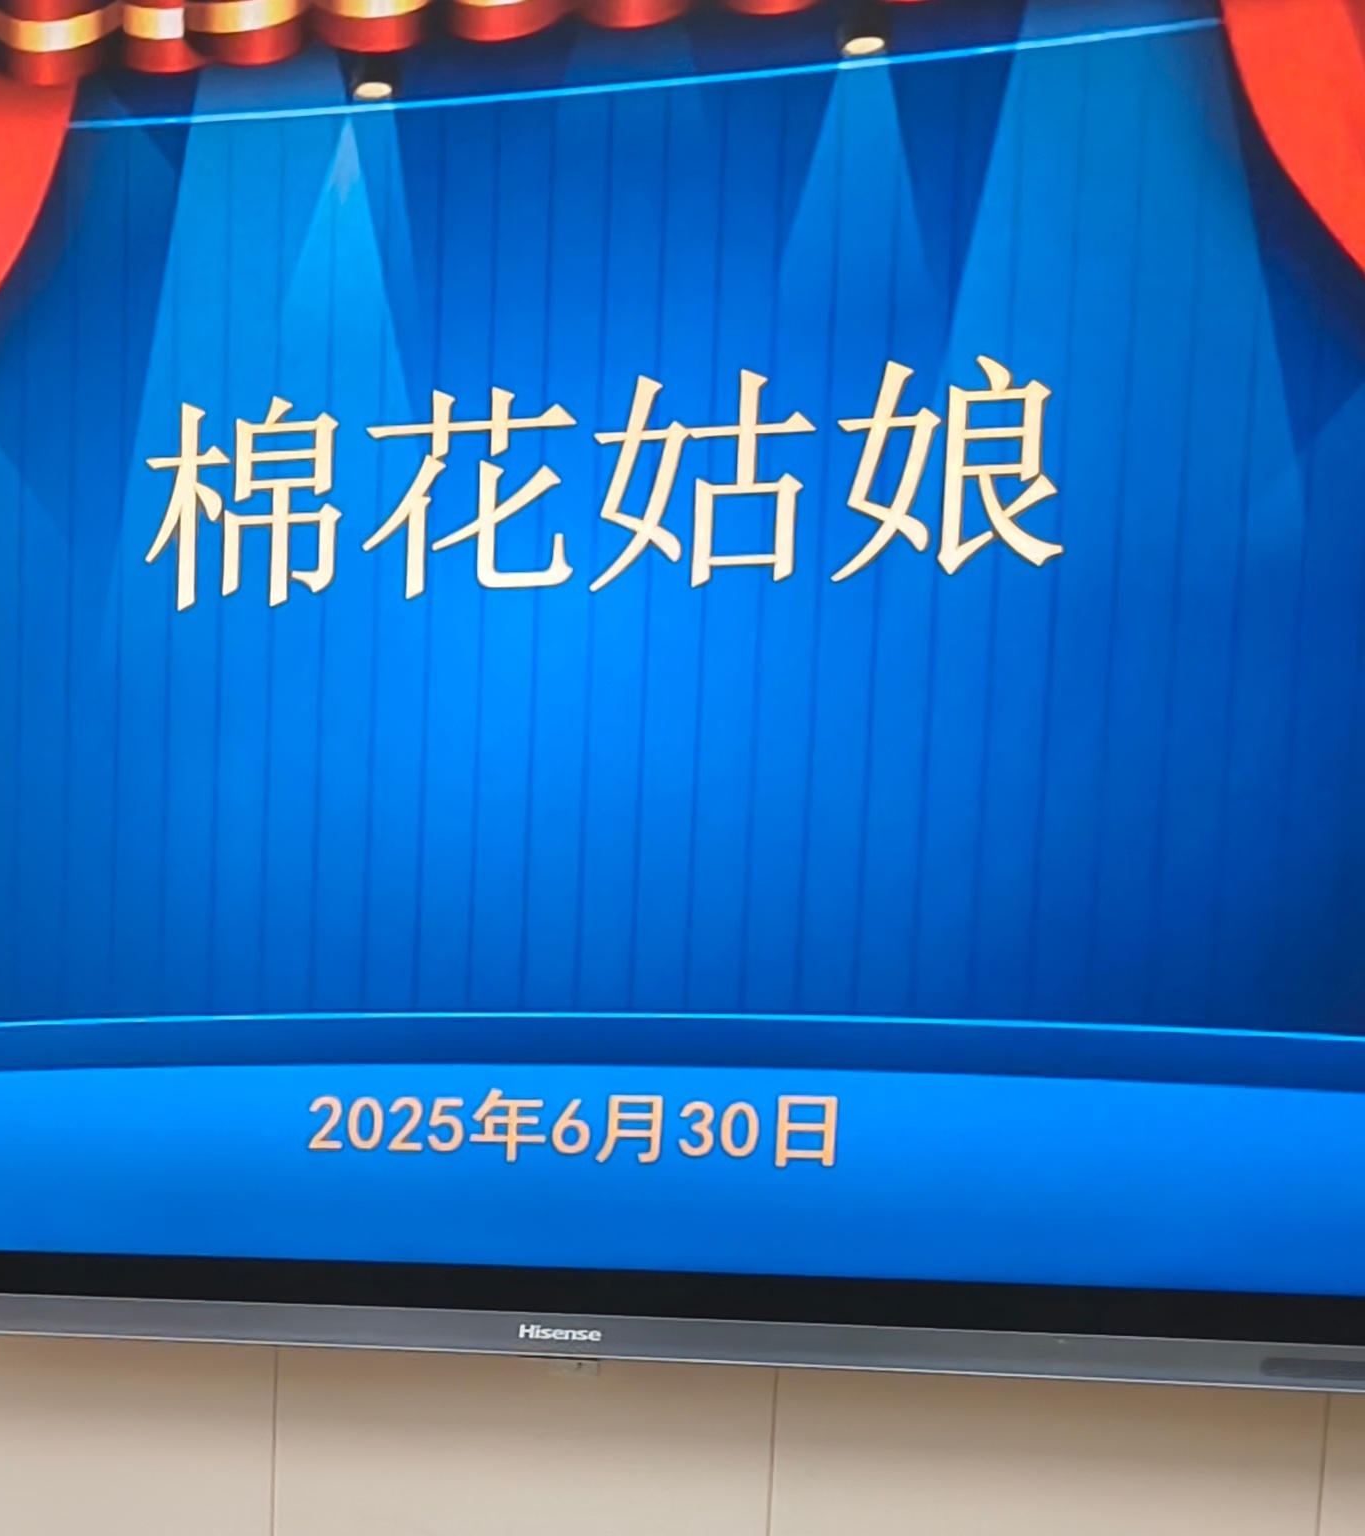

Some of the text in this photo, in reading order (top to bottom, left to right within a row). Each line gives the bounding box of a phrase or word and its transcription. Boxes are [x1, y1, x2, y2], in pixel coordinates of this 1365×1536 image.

[144, 355, 1065, 610] 棉花姑娘
[307, 1087, 838, 1168] 2025年6月30日
[518, 1323, 602, 1342] Hisense
